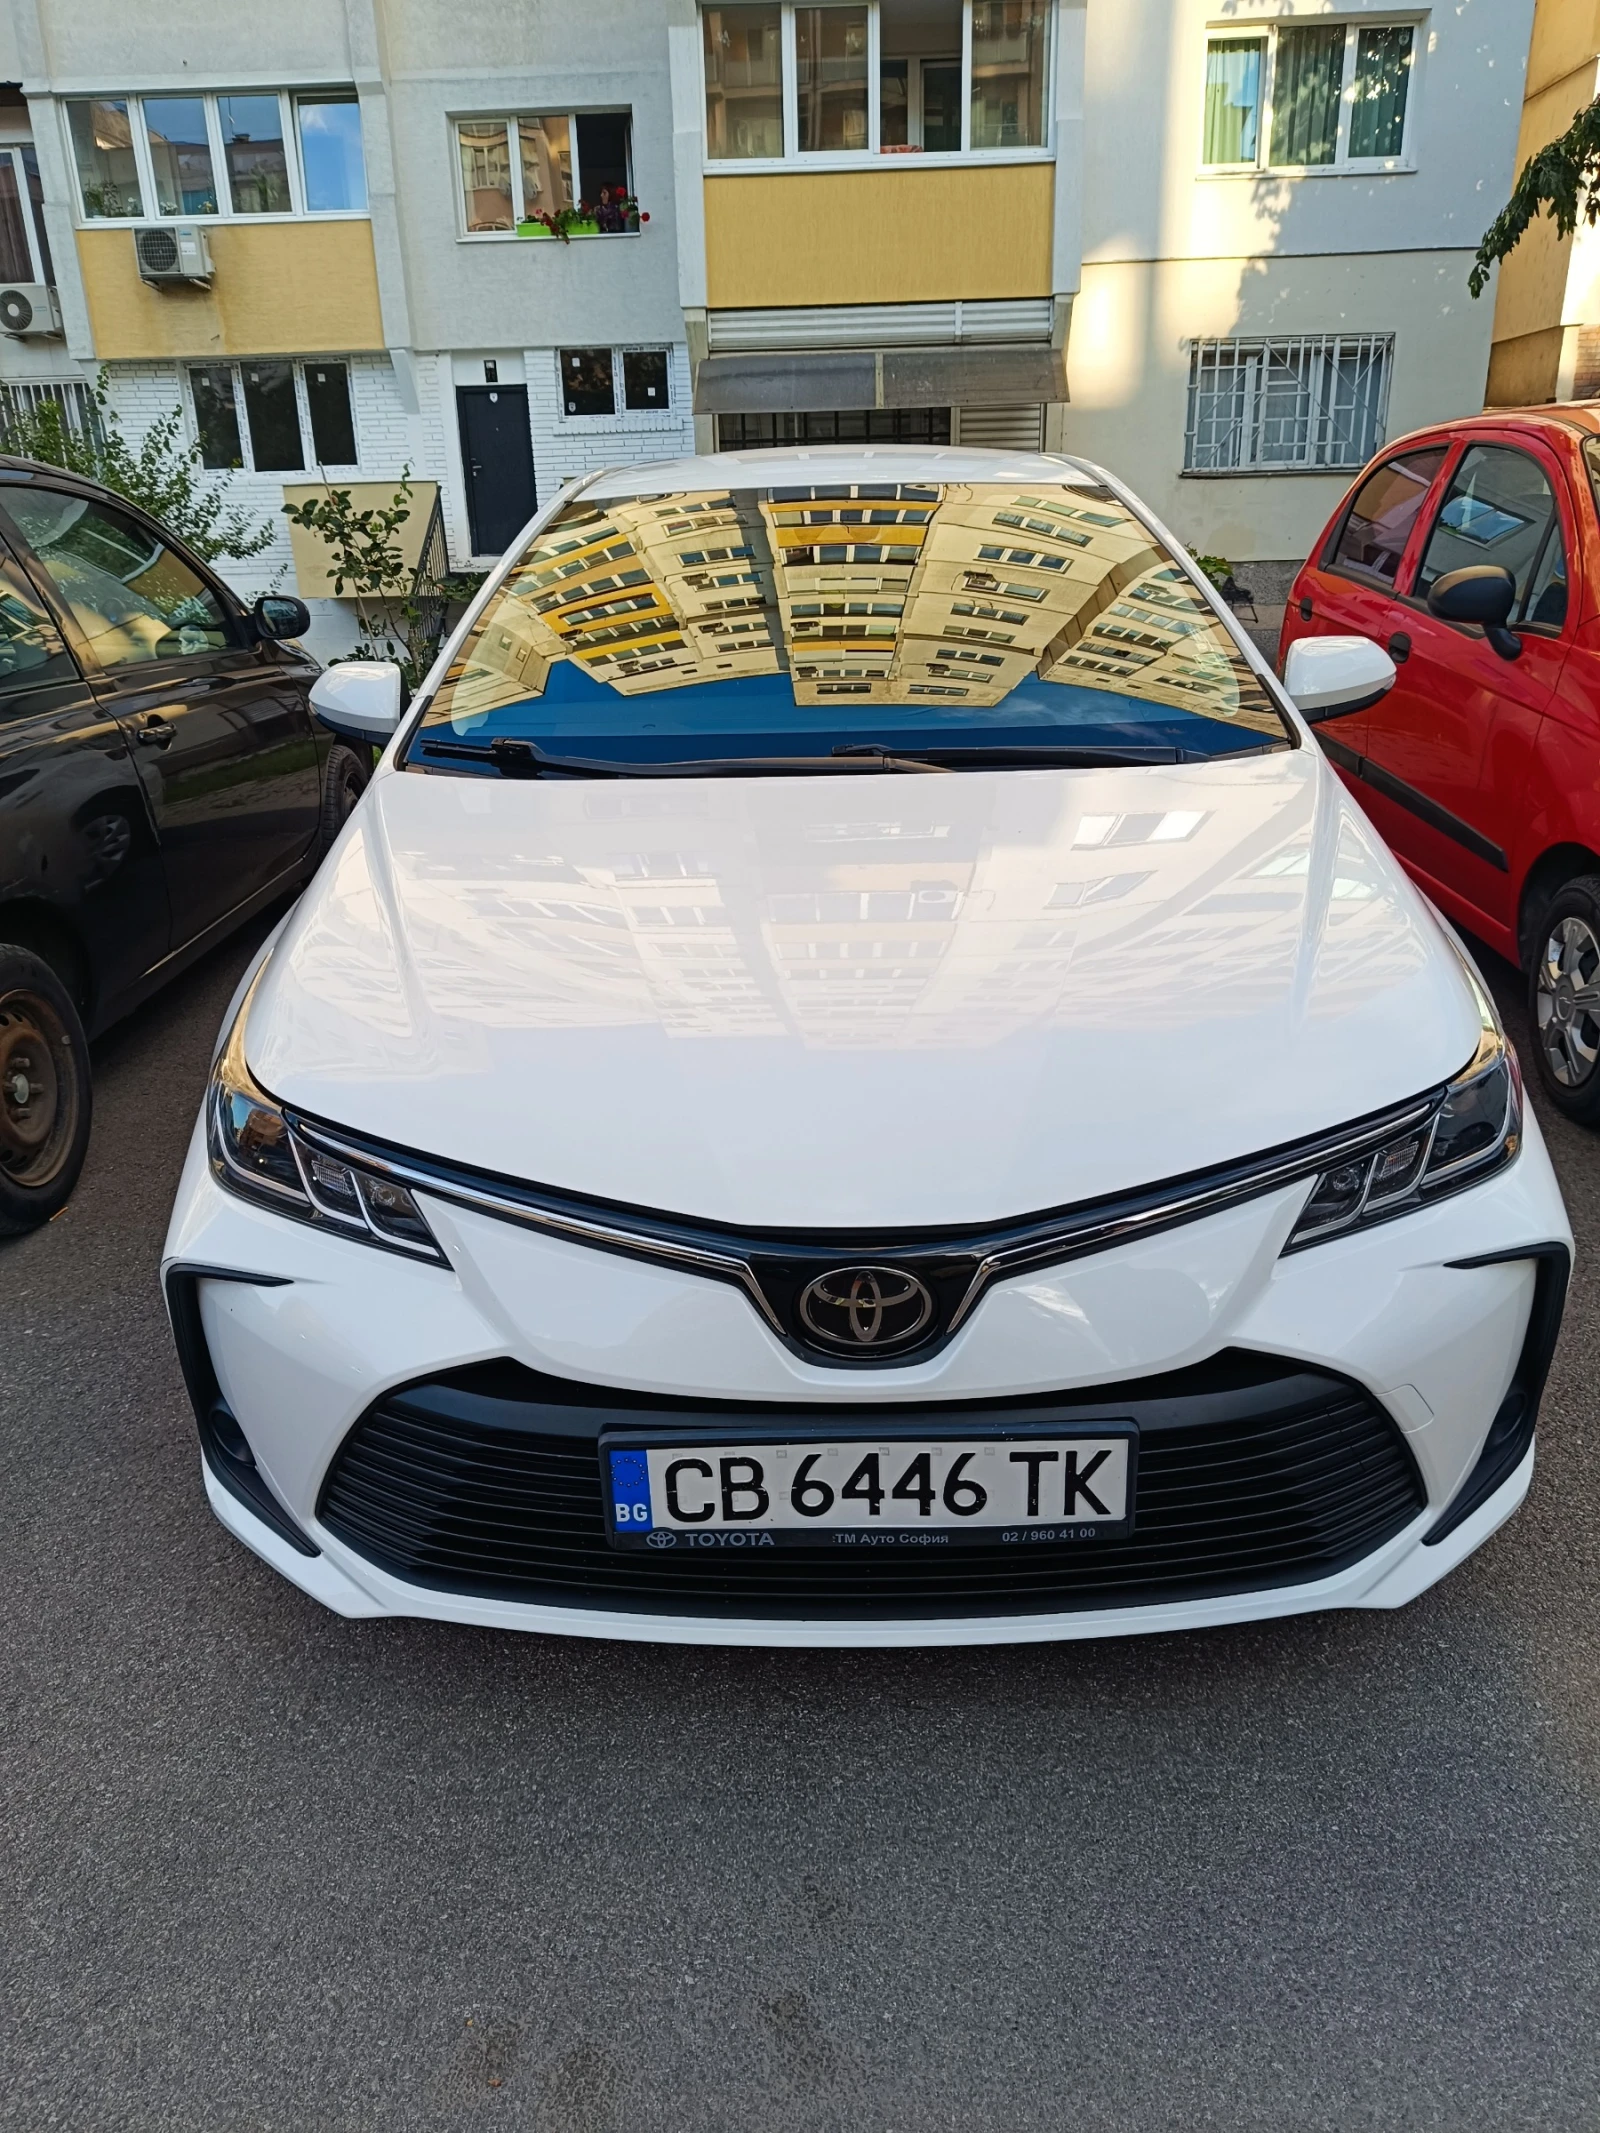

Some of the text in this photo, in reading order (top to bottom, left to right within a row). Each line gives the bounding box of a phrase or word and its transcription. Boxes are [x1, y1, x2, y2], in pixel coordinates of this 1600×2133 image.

[664, 1449, 1113, 1523] CB 6446 TK
[615, 1503, 648, 1523] BG
[684, 1532, 775, 1546] TOYOTA
[899, 1534, 949, 1546] София
[1001, 1531, 1018, 1543] 02
[1031, 1529, 1055, 1542] 960
[1059, 1528, 1075, 1540] 41
[1079, 1528, 1096, 1538] 00
